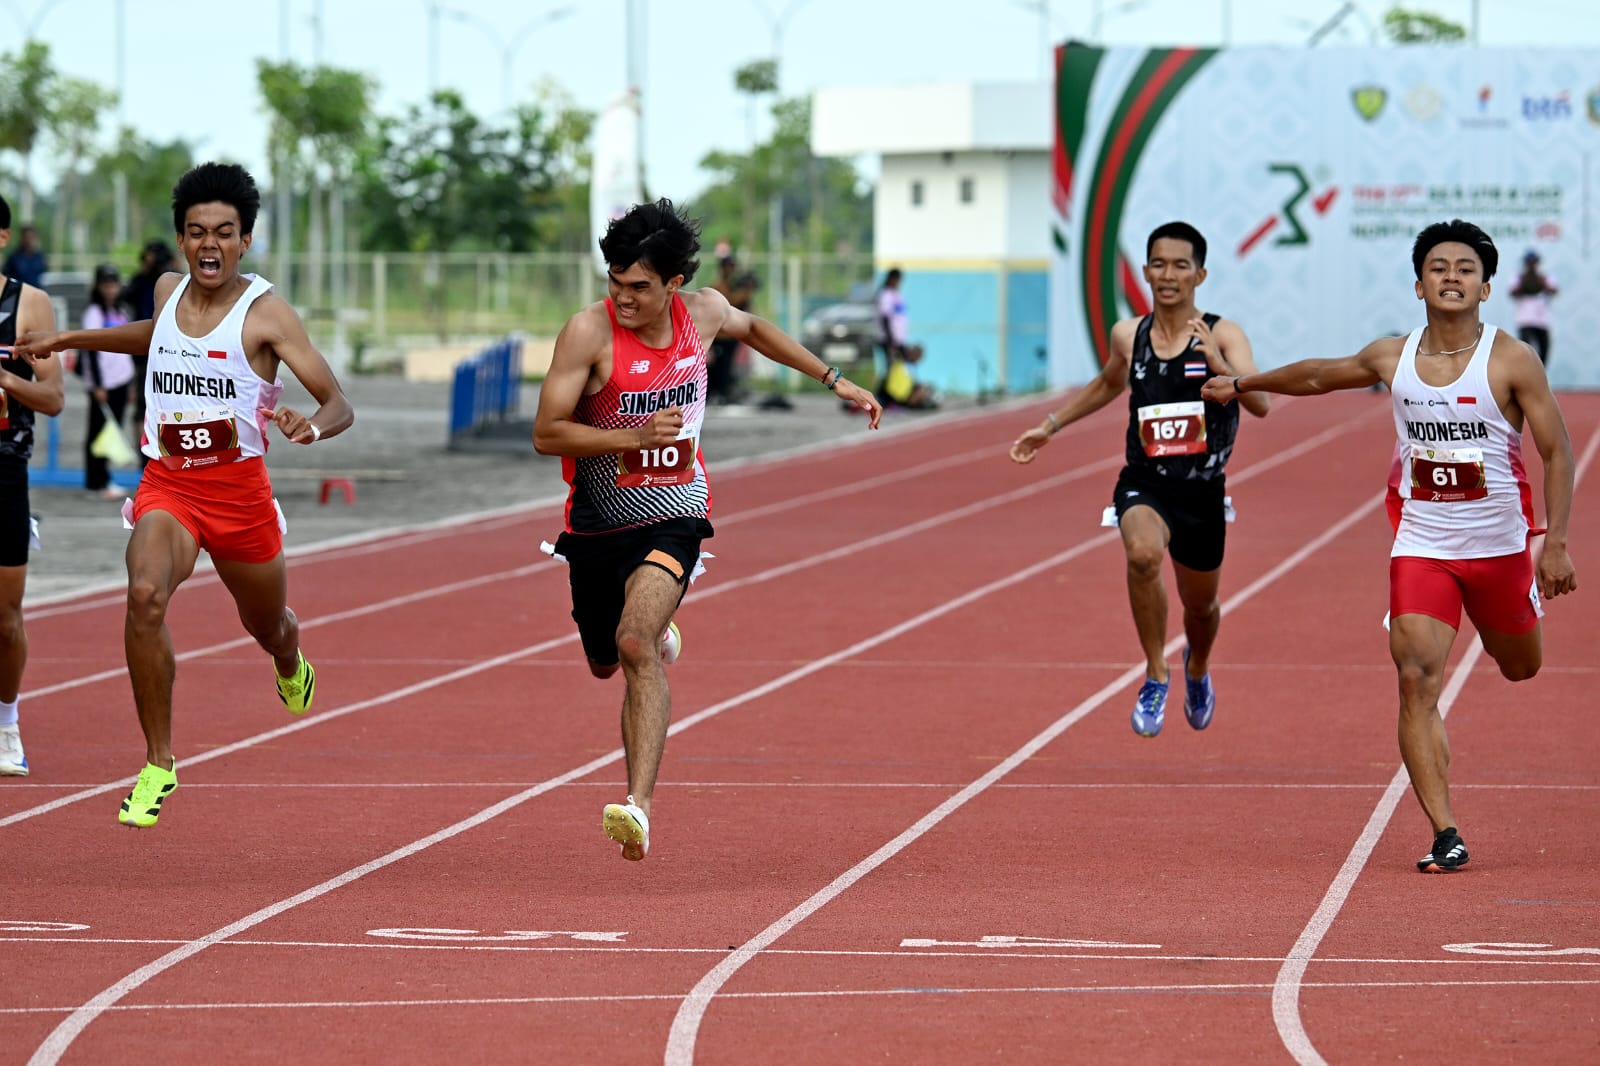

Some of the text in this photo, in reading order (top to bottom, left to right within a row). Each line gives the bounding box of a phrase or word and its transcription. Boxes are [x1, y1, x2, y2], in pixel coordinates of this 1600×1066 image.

[153, 371, 237, 399] INDONESIA
[619, 380, 699, 415] SINGAPORE
[179, 428, 212, 450] 38
[1151, 419, 1188, 440] 167
[1405, 420, 1488, 442] INDONESIA
[640, 446, 679, 468] 110
[1432, 466, 1458, 486] 61
